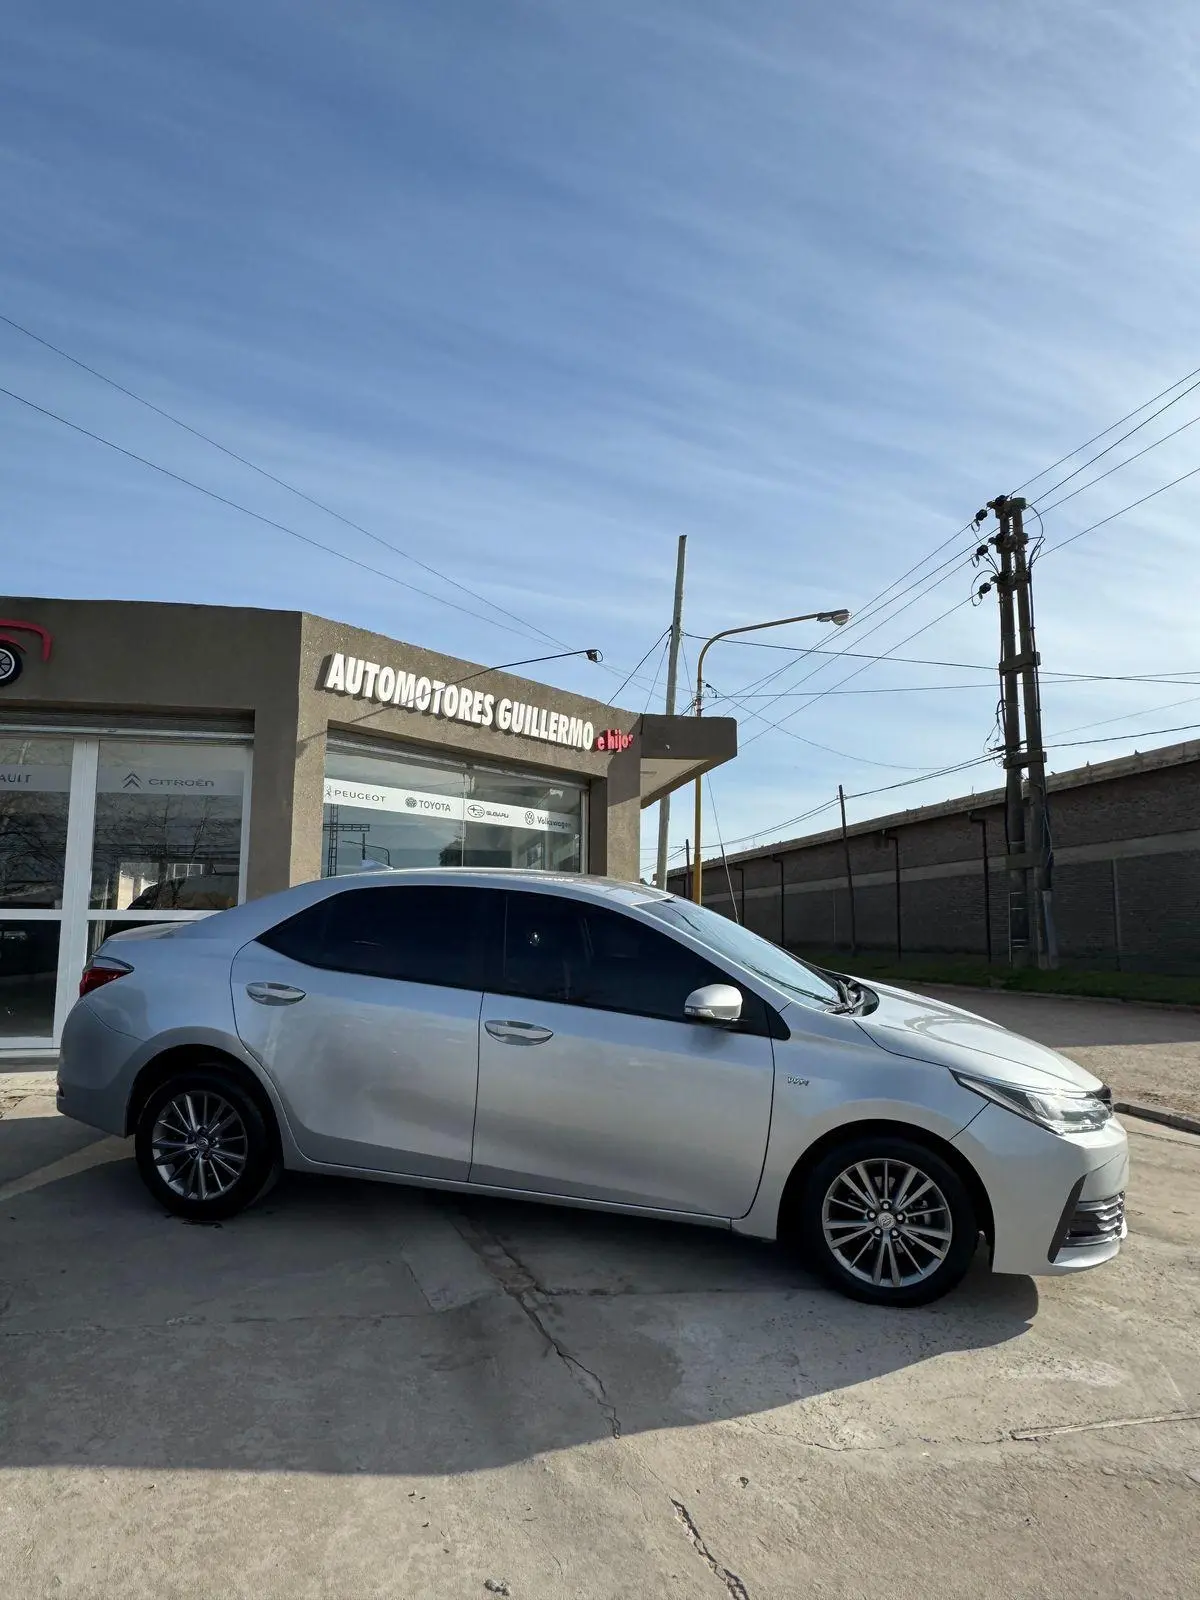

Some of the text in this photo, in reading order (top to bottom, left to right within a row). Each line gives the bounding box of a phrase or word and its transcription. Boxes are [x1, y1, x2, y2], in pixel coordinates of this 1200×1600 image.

[325, 652, 495, 727] AUTOMOTORES
[496, 698, 595, 750] GUILLERMO
[597, 736, 605, 750] e
[334, 789, 387, 803] PEUGEOT
[418, 800, 452, 813] TOYOTA
